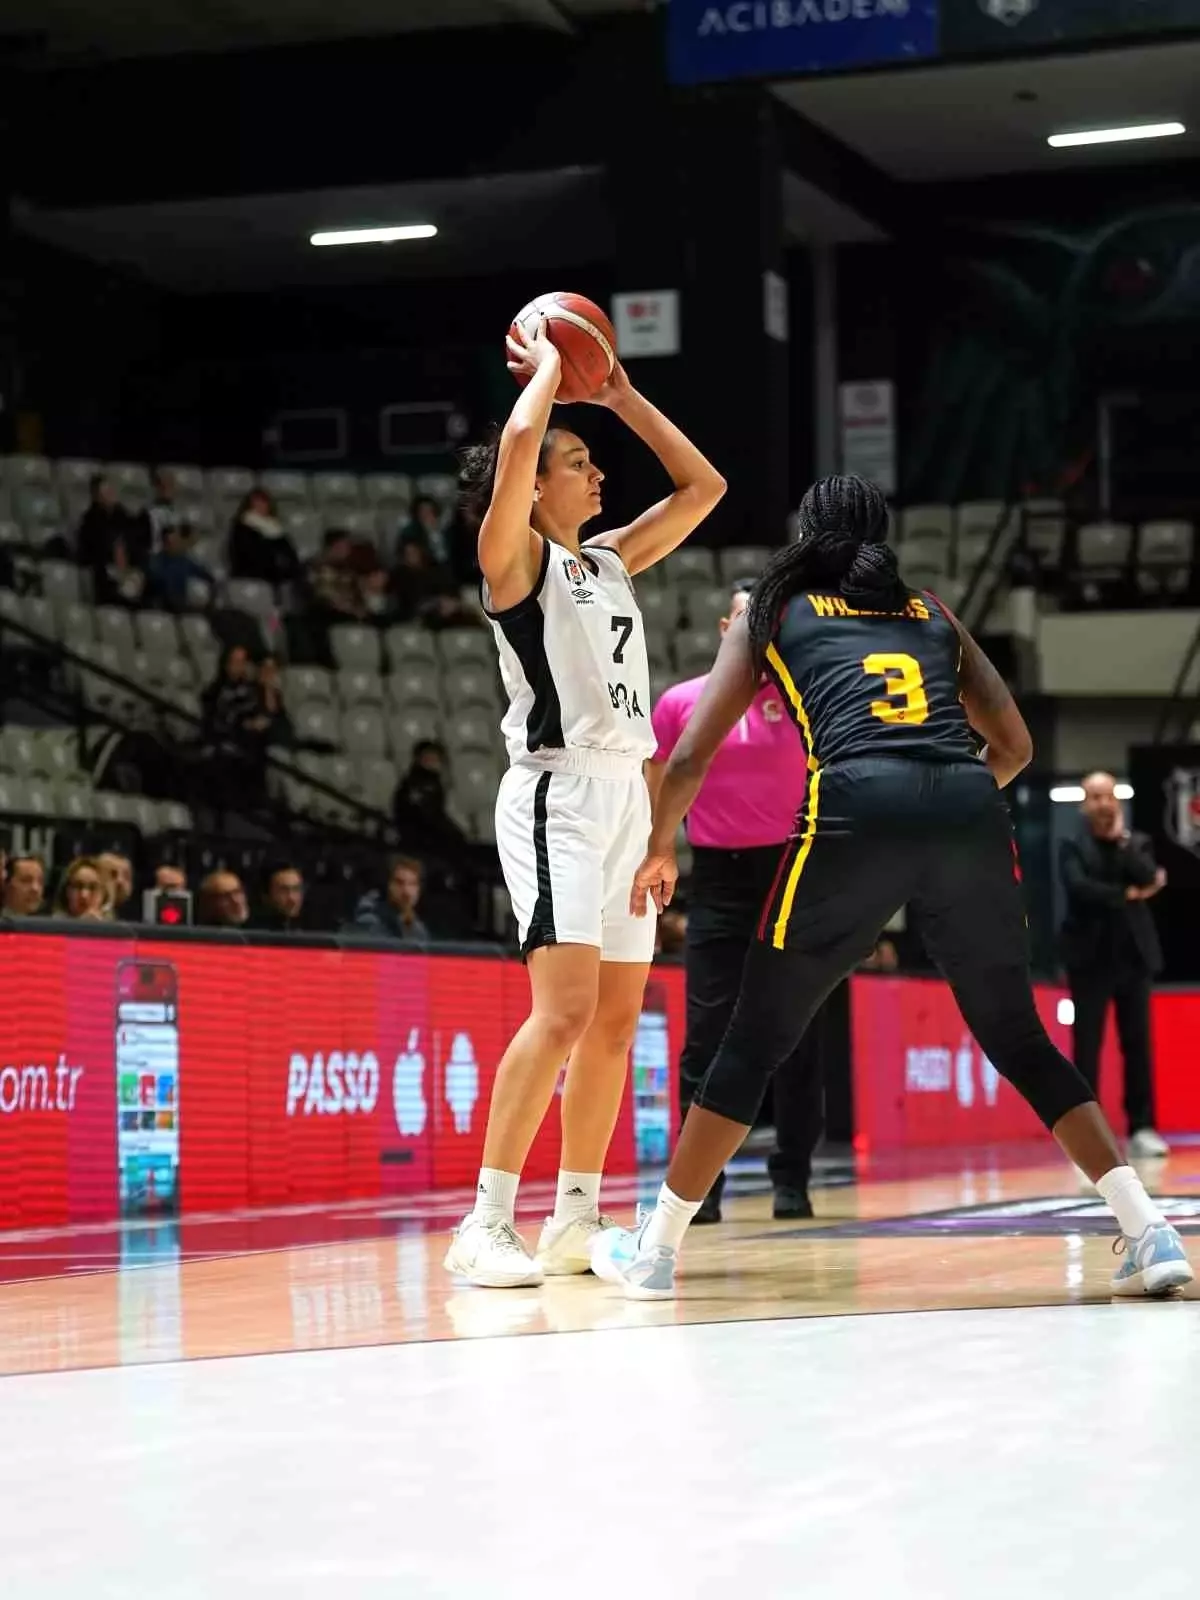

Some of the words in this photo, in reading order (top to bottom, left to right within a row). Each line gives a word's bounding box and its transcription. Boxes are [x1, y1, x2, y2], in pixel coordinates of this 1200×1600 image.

[807, 594, 929, 620] WILS
[611, 615, 633, 664] 7
[862, 652, 929, 725] 3
[286, 1051, 379, 1116] PASSO
